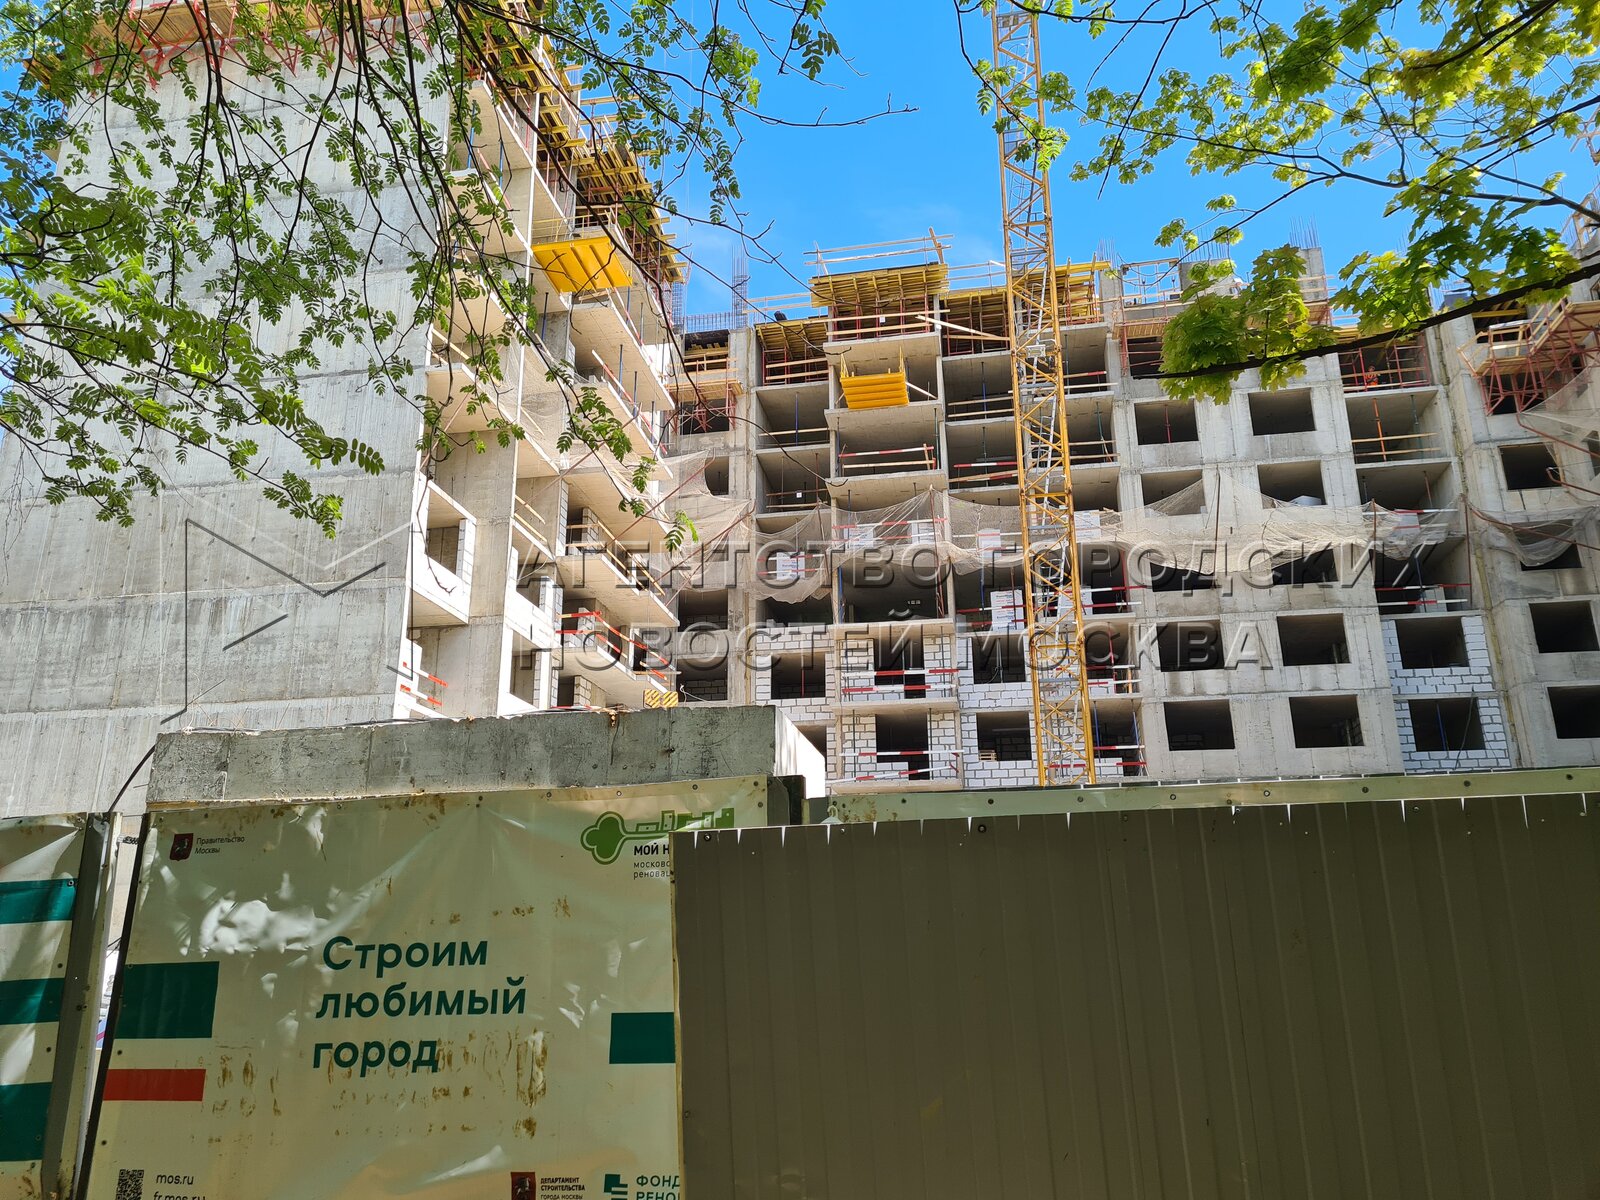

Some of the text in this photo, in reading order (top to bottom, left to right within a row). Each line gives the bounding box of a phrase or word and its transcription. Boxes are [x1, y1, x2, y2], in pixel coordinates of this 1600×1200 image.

[196, 836, 245, 846] Правительство
[633, 843, 659, 855] МОЙ
[322, 935, 488, 979] Строим
[315, 976, 526, 1019] любимый
[312, 1040, 440, 1078] город
[155, 1173, 195, 1185] mos.ru
